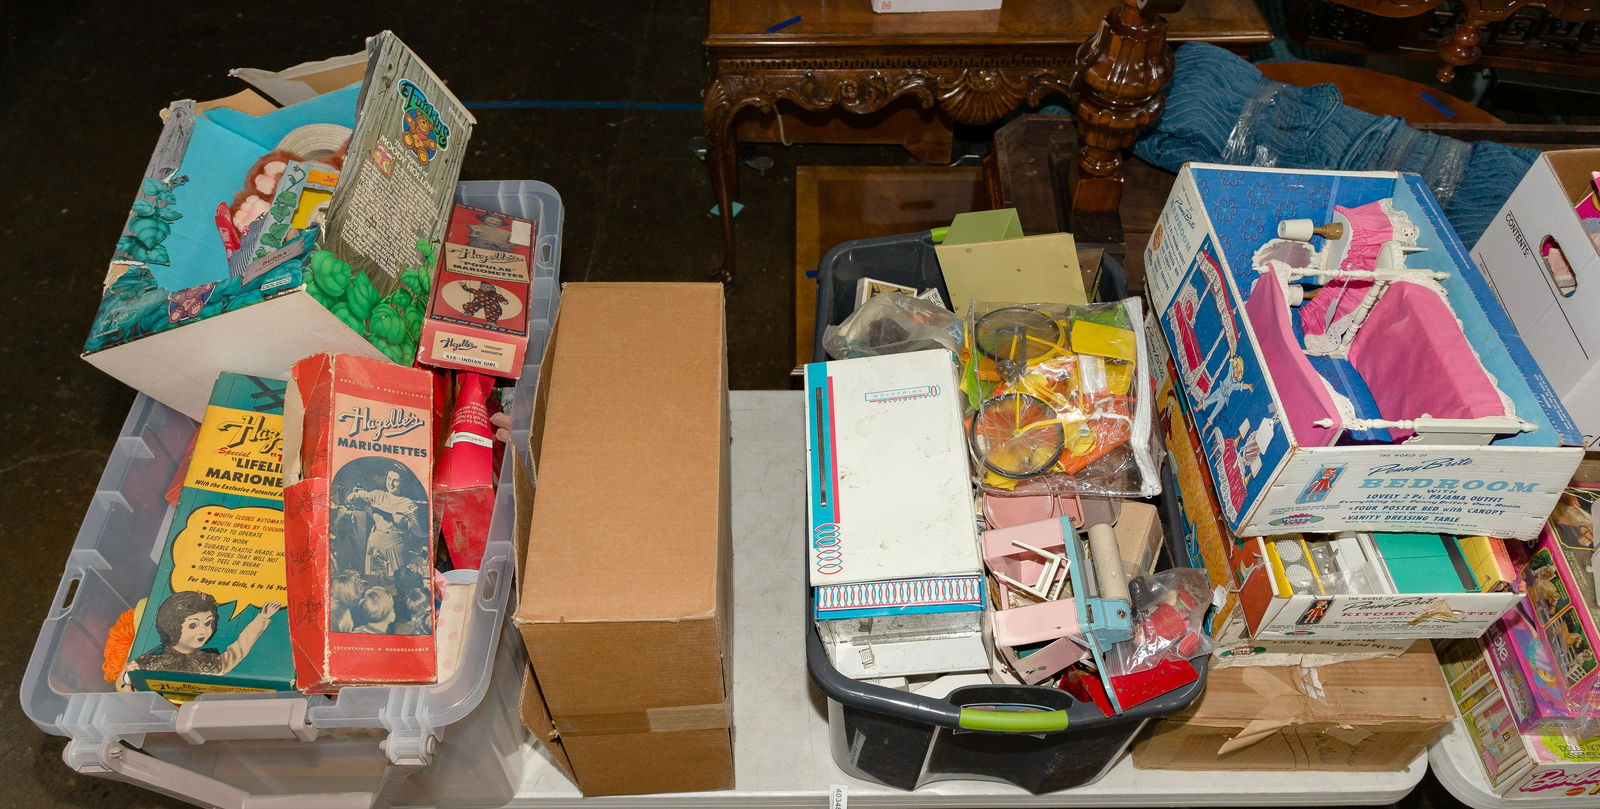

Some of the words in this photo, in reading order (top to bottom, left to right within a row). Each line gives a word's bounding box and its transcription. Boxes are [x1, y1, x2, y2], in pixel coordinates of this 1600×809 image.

[380, 135, 407, 164] MOODY
[406, 163, 435, 195] HOLLOW
[1505, 213, 1529, 258] CONTENTS:
[453, 264, 524, 279] MARIONETTES
[383, 387, 427, 399] EDUCATIONAL
[872, 388, 924, 399] WOLVERINE
[337, 407, 425, 441] Hazelle's
[218, 447, 252, 458] Special
[337, 437, 428, 458] MARIONETTES
[232, 456, 283, 474] "LIFELI
[1367, 463, 1419, 477] Penny
[1421, 457, 1473, 470] Brite
[205, 467, 283, 488] MARIONE
[195, 479, 209, 487] With
[222, 483, 250, 493] Exclusive
[250, 488, 277, 497] Patented
[1357, 478, 1541, 494] BEDROOM
[1470, 495, 1504, 503] OUTFIT
[1467, 508, 1506, 516] CANOPY
[235, 514, 255, 522] CLOSES
[256, 517, 285, 525] AUTOMATI
[209, 526, 228, 534] READY
[203, 543, 229, 551] DURABLE
[231, 546, 253, 554] PLASTIC
[217, 551, 236, 559] SHOES
[197, 565, 238, 575] INSTRUCTIONS
[241, 561, 261, 569] BREAK
[200, 577, 216, 585] Boys
[232, 581, 248, 589] Girls,
[1392, 597, 1438, 608] Brit
